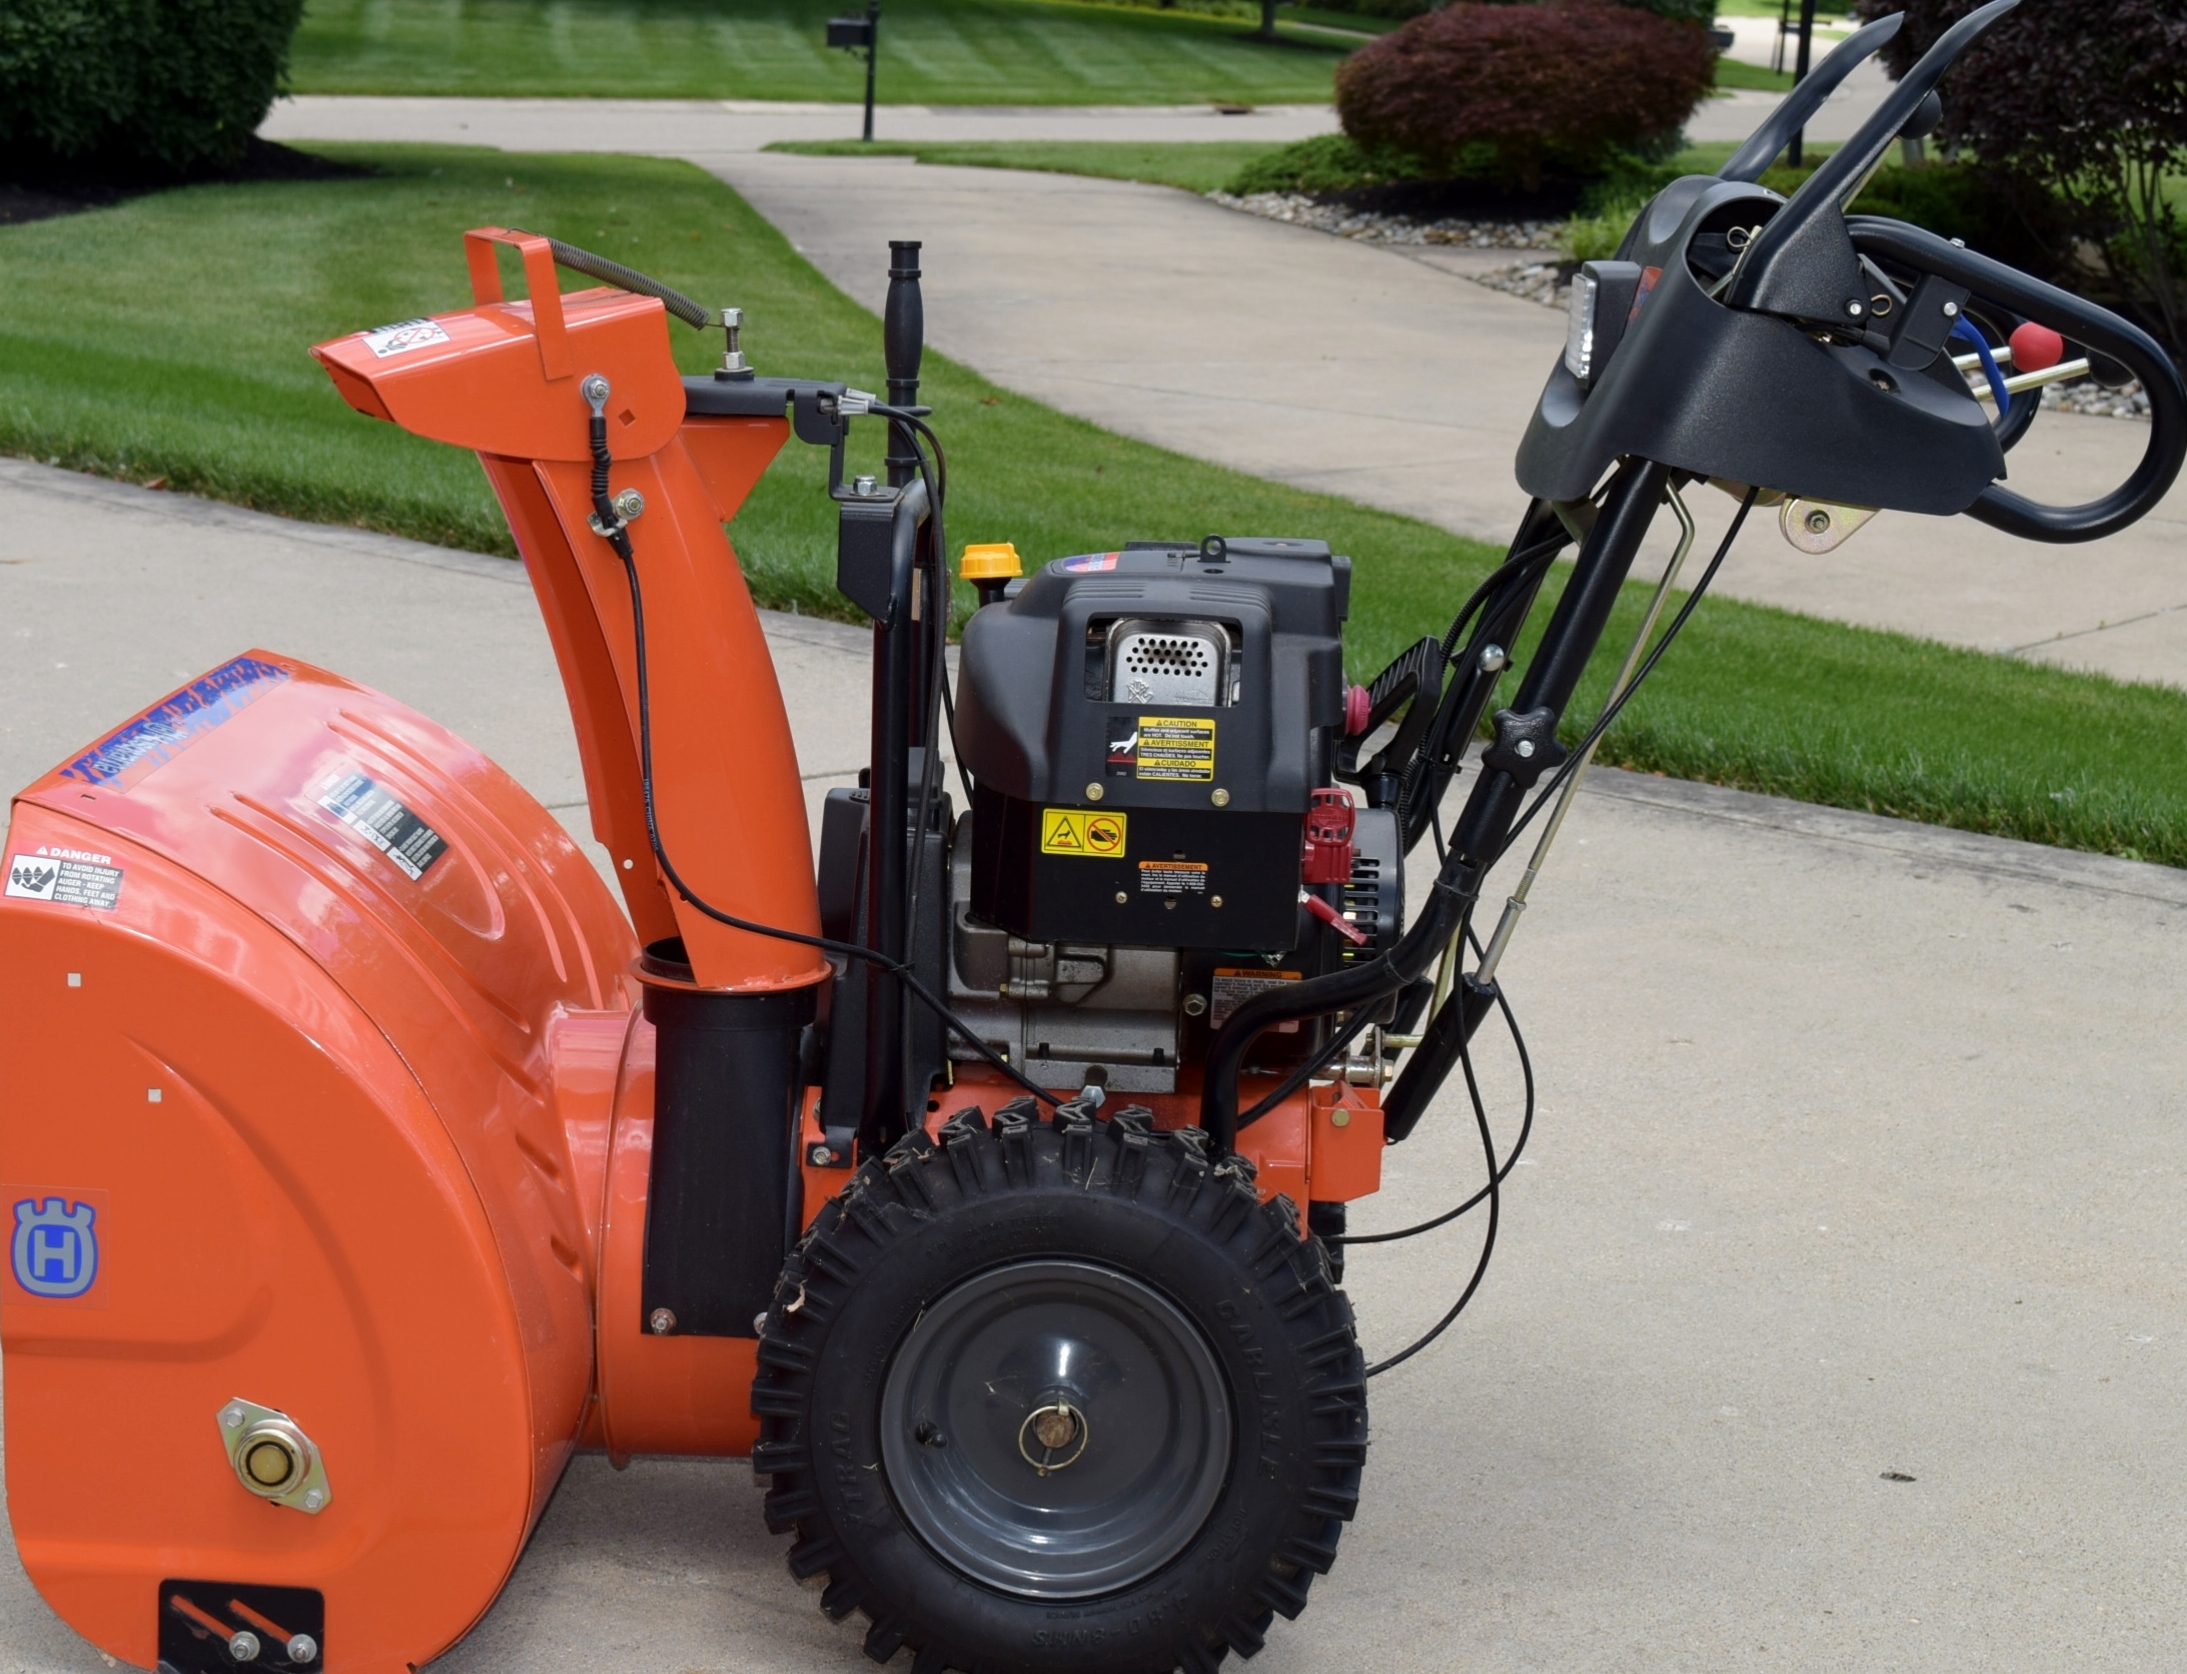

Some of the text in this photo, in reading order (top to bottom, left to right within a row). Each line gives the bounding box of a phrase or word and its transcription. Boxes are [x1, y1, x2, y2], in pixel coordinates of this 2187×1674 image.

[50, 848, 112, 864] DANGER
[60, 870, 115, 884] FROM ROTATING
[72, 864, 93, 873] AVOID
[94, 867, 119, 877] INJURY
[58, 878, 81, 886] AUGER
[54, 893, 111, 908] CLOTHING AWAY.
[1242, 970, 1282, 978] WARNING
[1216, 1299, 1282, 1477] CARLISLE
